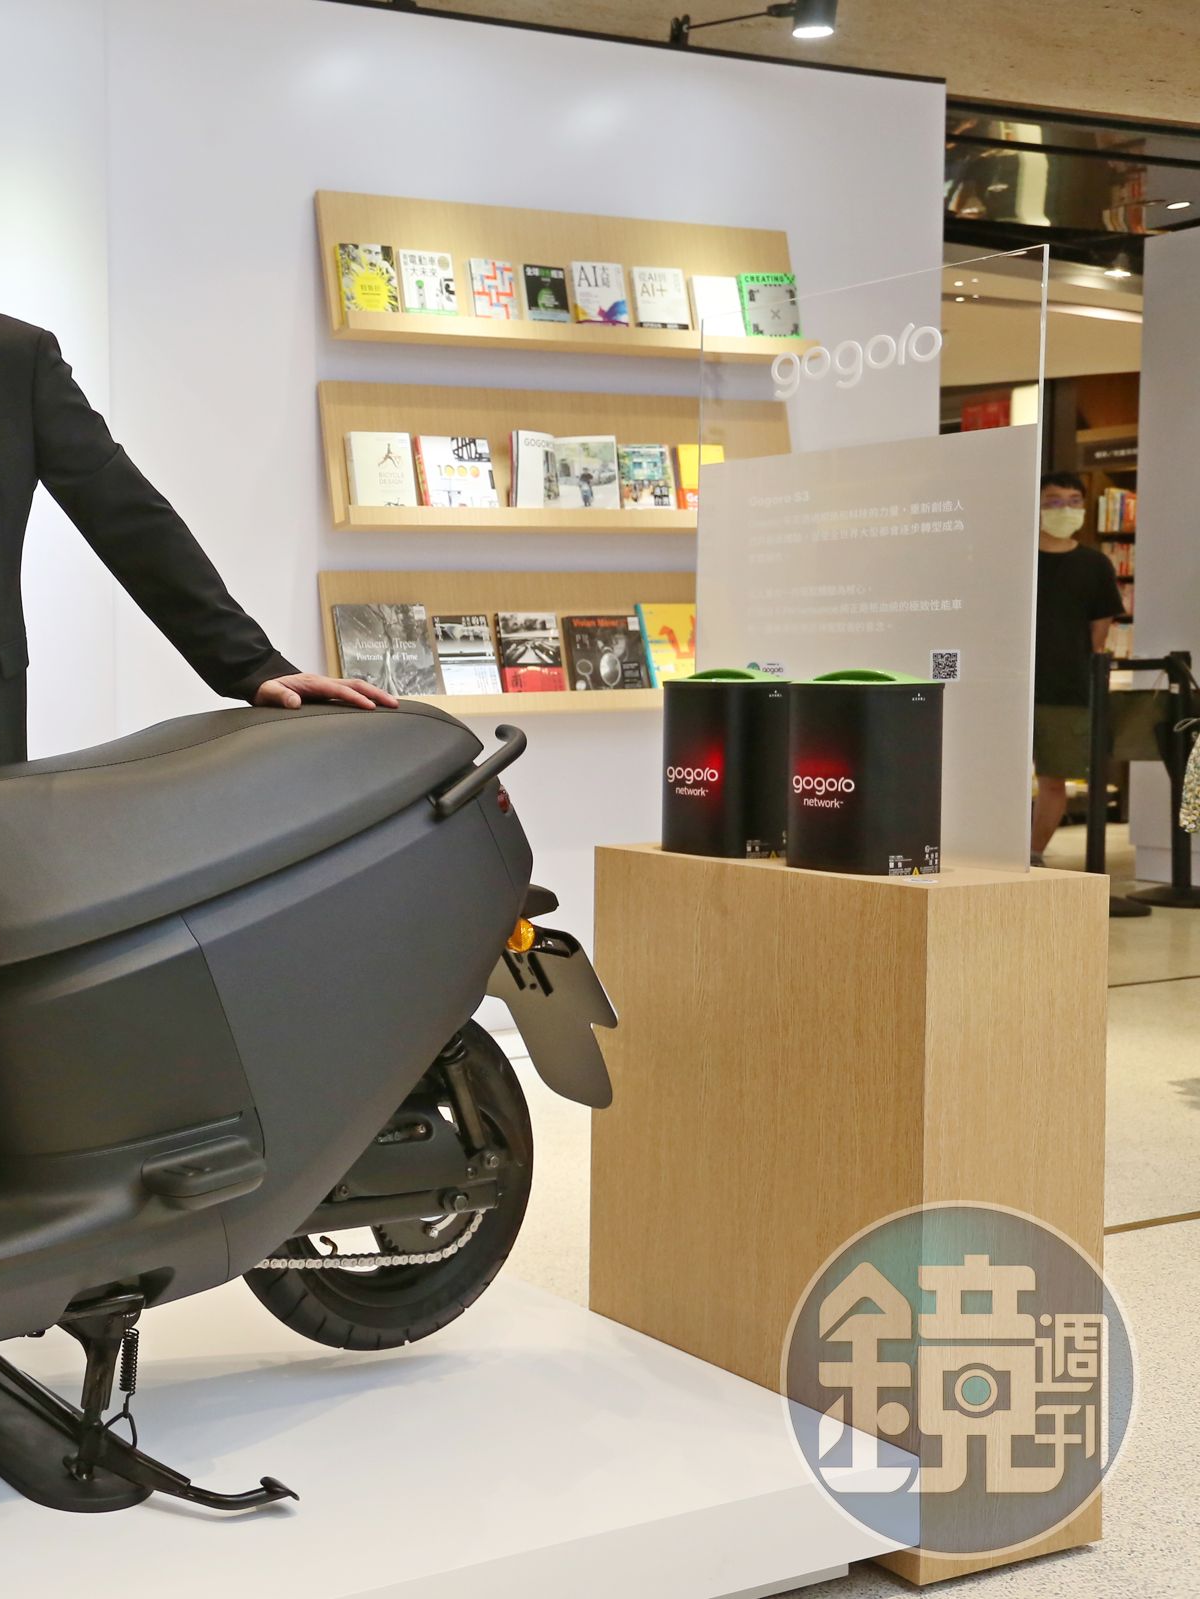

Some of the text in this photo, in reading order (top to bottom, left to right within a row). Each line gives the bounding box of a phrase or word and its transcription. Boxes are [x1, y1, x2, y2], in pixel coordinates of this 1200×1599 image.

[771, 322, 943, 399] gogoro
[354, 637, 417, 649] Ancient Trees
[355, 653, 384, 662] Portraits
[402, 653, 418, 661] Time
[666, 765, 719, 784] gogoro
[792, 774, 856, 796] gogoro
